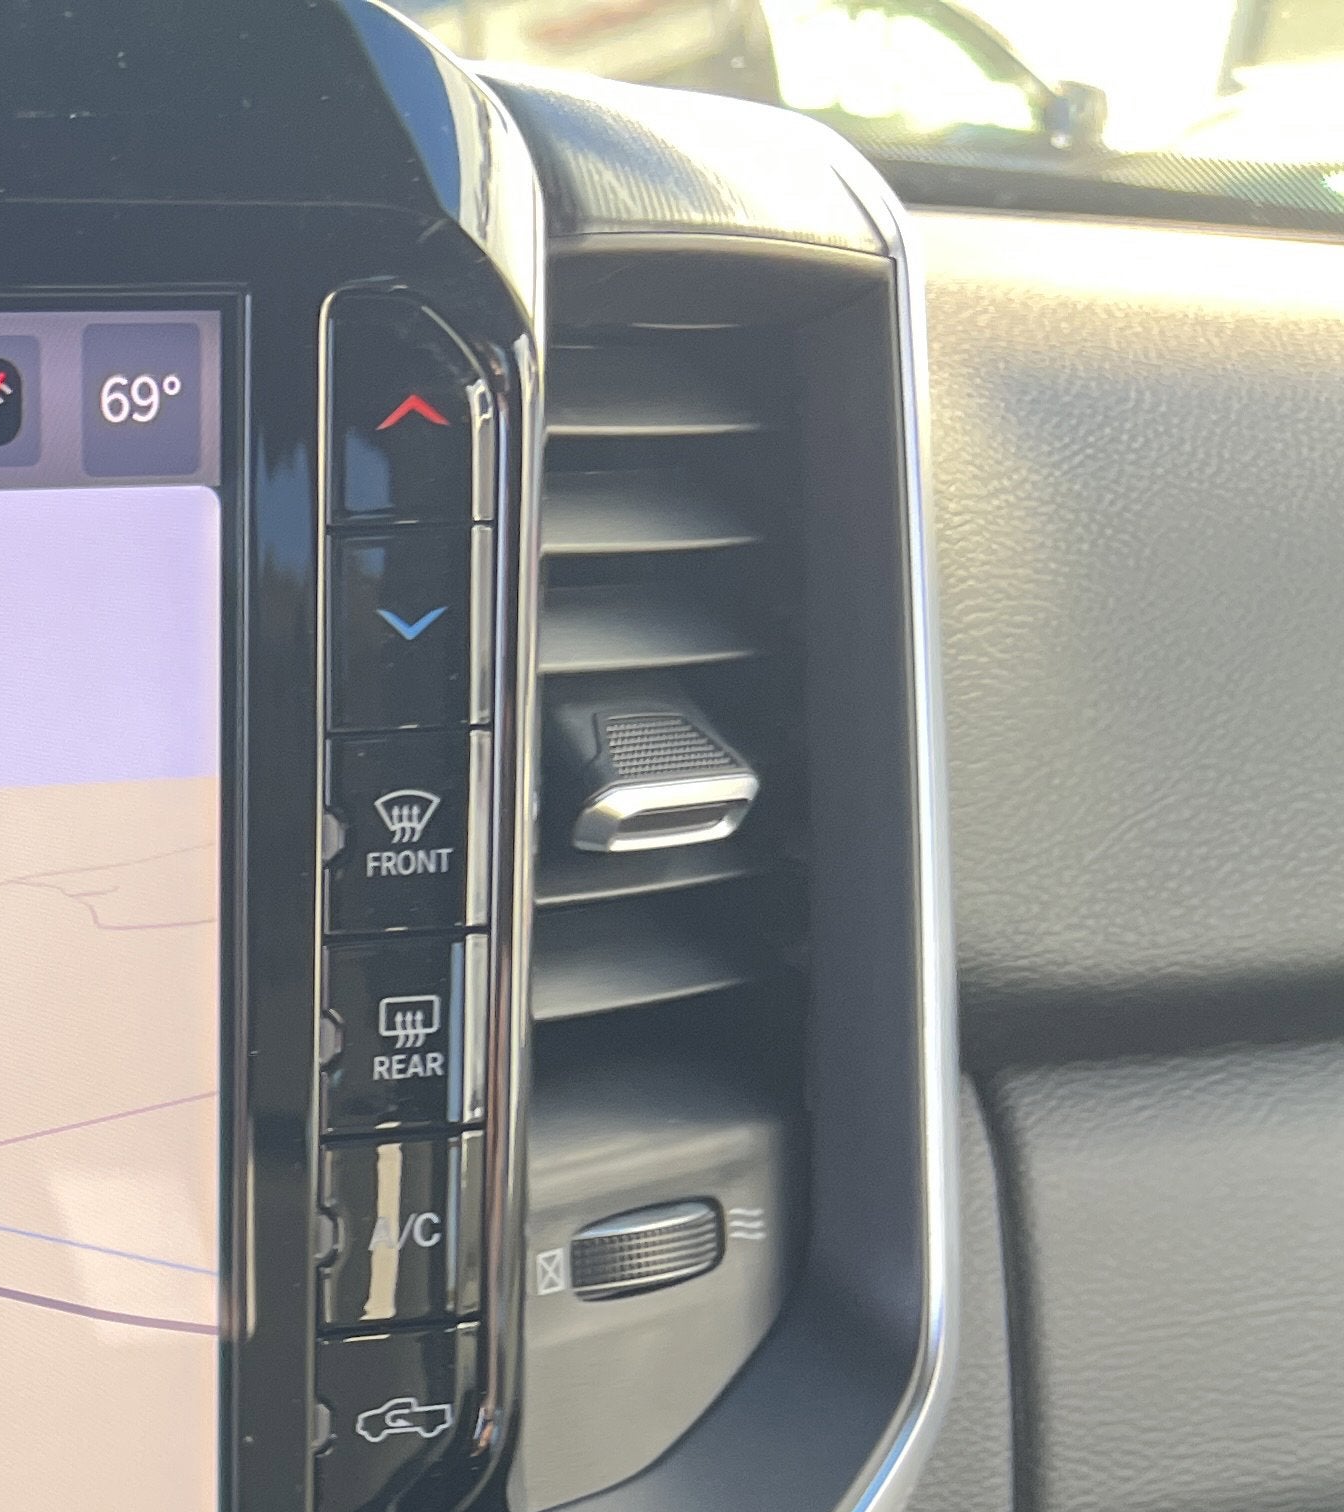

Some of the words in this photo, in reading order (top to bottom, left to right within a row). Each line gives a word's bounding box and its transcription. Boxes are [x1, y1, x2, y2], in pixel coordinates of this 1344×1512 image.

[100, 374, 182, 424] 69°
[366, 848, 453, 876] FRONT
[372, 1053, 444, 1080] REAR
[368, 1213, 441, 1250] A/C
